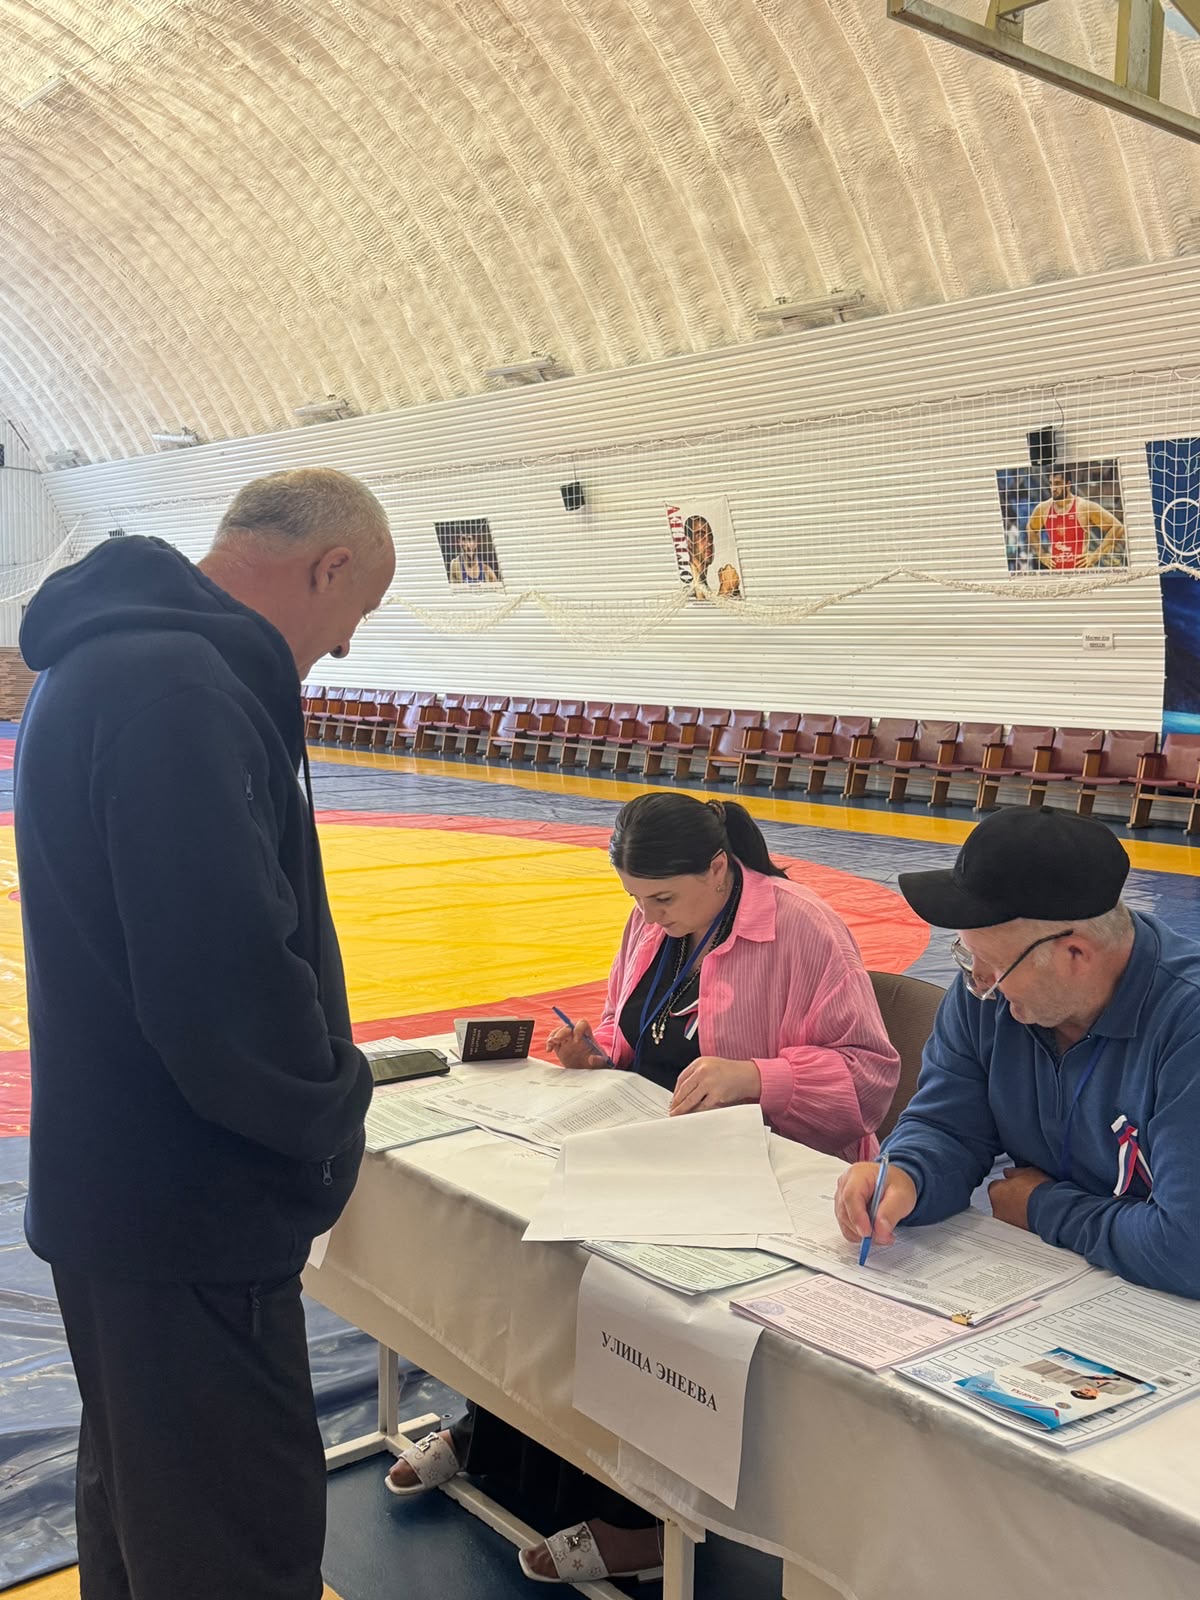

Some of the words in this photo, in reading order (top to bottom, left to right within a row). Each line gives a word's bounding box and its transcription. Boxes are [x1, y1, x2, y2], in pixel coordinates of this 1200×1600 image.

[665, 505, 694, 589] OTTUEV
[515, 1026, 527, 1053] ПАСПОРТ
[601, 1331, 651, 1374] УЛИЦА
[656, 1362, 718, 1412] ЭНЕЕВА
